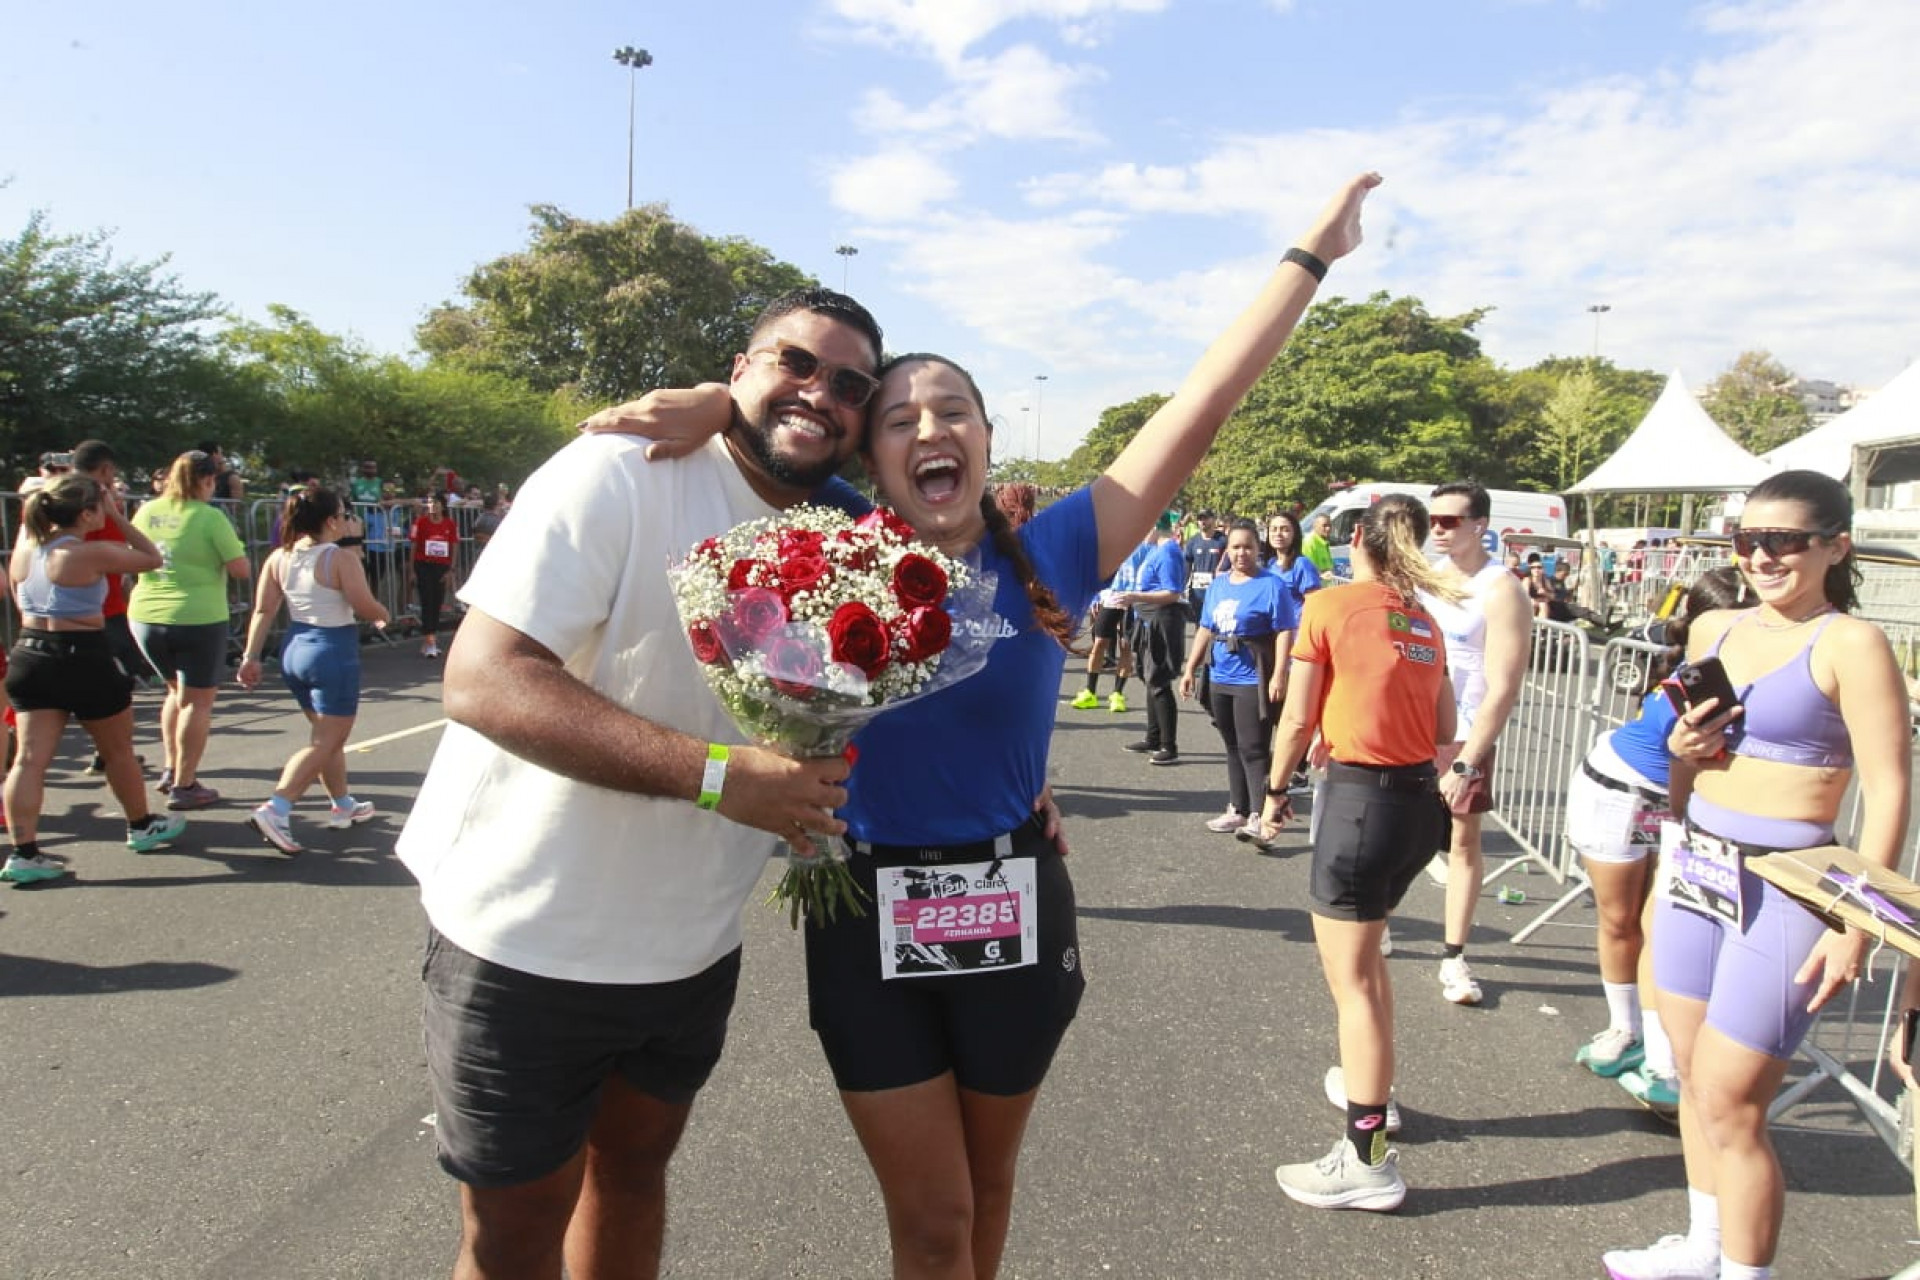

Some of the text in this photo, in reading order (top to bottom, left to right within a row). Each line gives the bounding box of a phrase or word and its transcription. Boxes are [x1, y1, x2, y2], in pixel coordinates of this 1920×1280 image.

[1745, 742, 1784, 760] NIKE
[974, 879, 1004, 889] Claro
[916, 900, 1017, 930] 22385
[944, 927, 992, 938] FERNANDA
